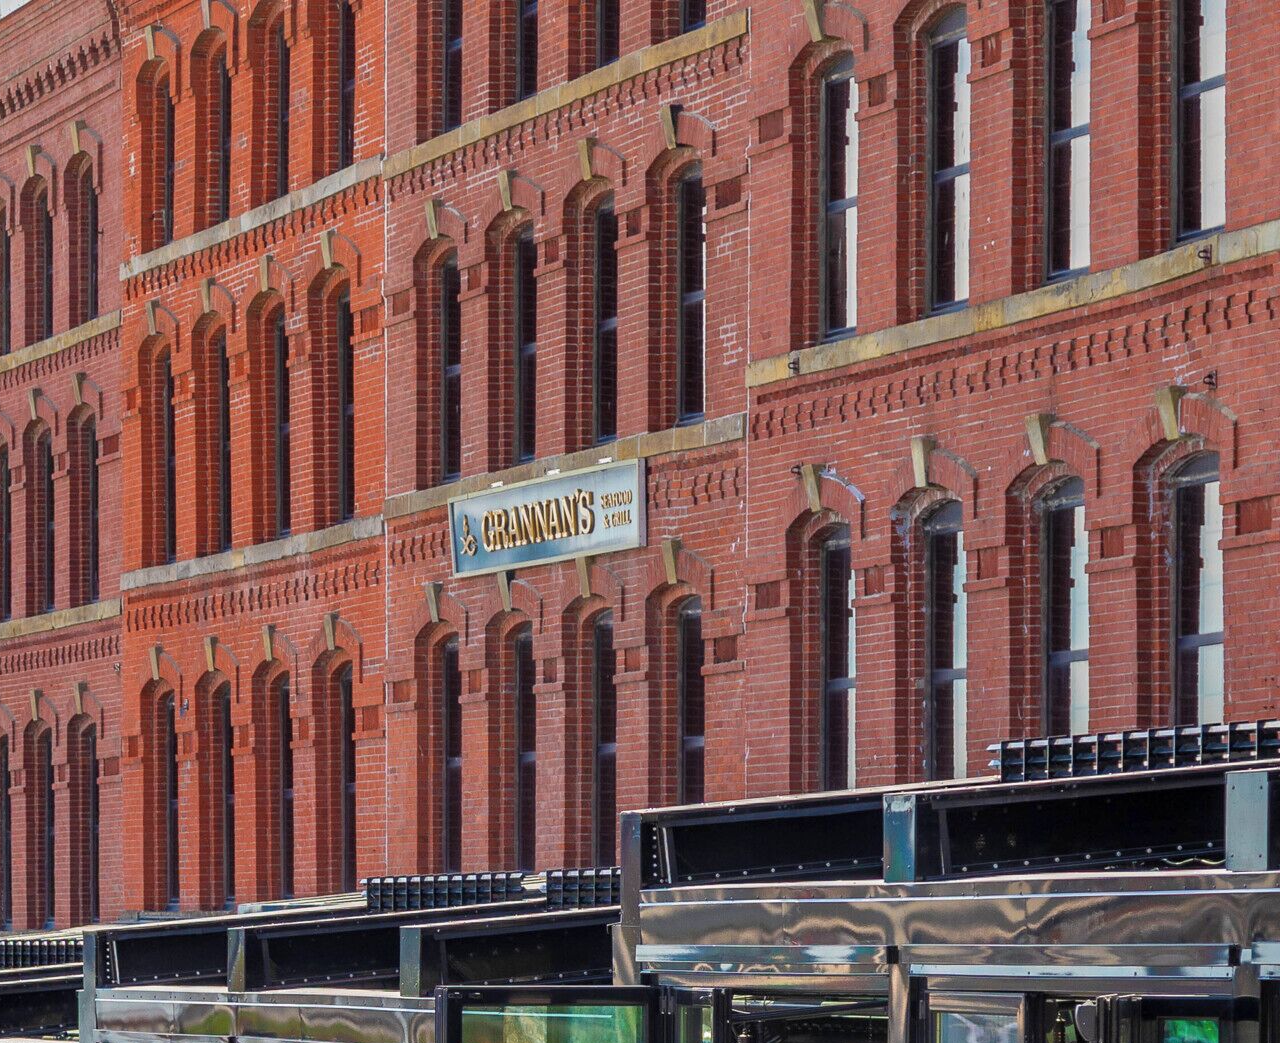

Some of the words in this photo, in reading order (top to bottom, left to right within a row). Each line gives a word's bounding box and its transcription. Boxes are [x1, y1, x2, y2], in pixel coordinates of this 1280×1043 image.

[600, 489, 633, 509] SEAFOOD
[482, 488, 594, 552] GRANNAN'S
[603, 515, 611, 529] &
[612, 509, 632, 527] GRILL
